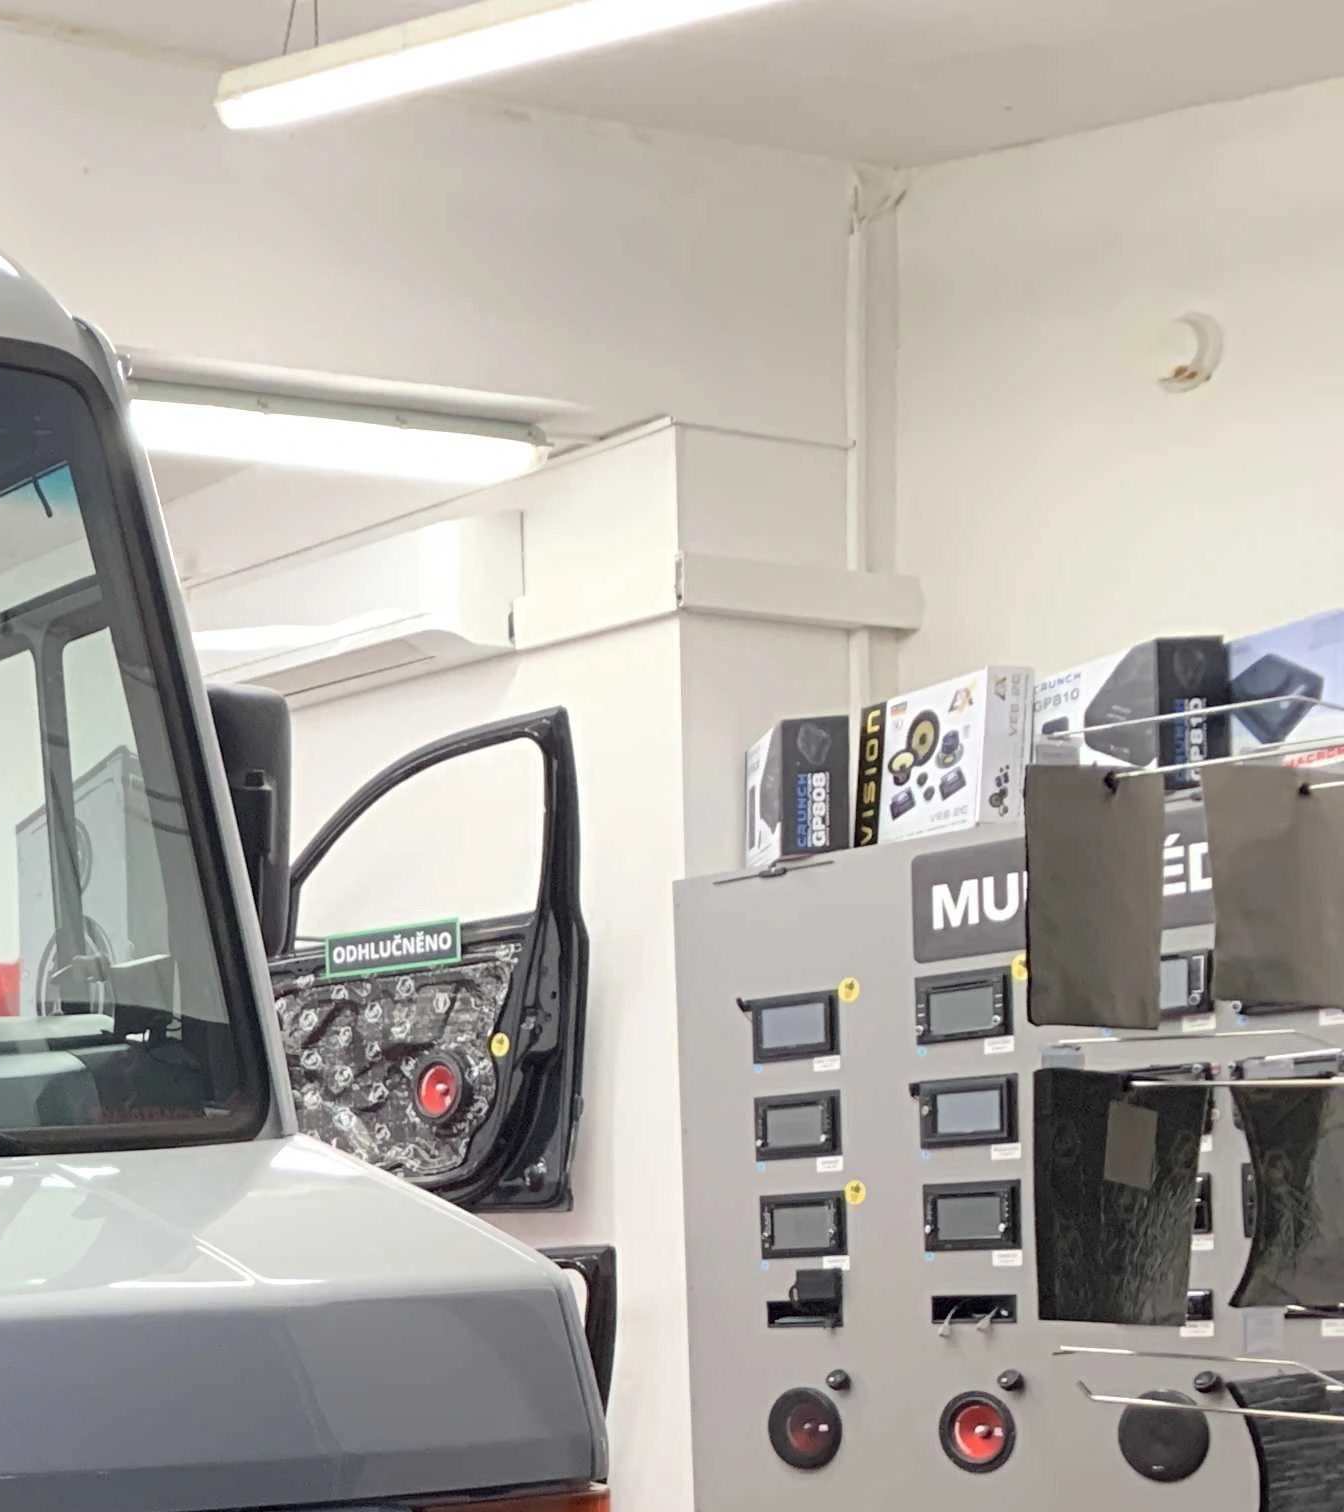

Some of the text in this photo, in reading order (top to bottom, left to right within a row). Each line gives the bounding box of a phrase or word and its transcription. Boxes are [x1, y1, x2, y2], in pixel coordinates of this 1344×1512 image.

[796, 773, 808, 848] CRUNCH
[812, 772, 826, 847] GP808
[859, 708, 882, 846] VISION
[931, 870, 1028, 931] MU
[332, 930, 452, 964] ODHLUČNĚNO
